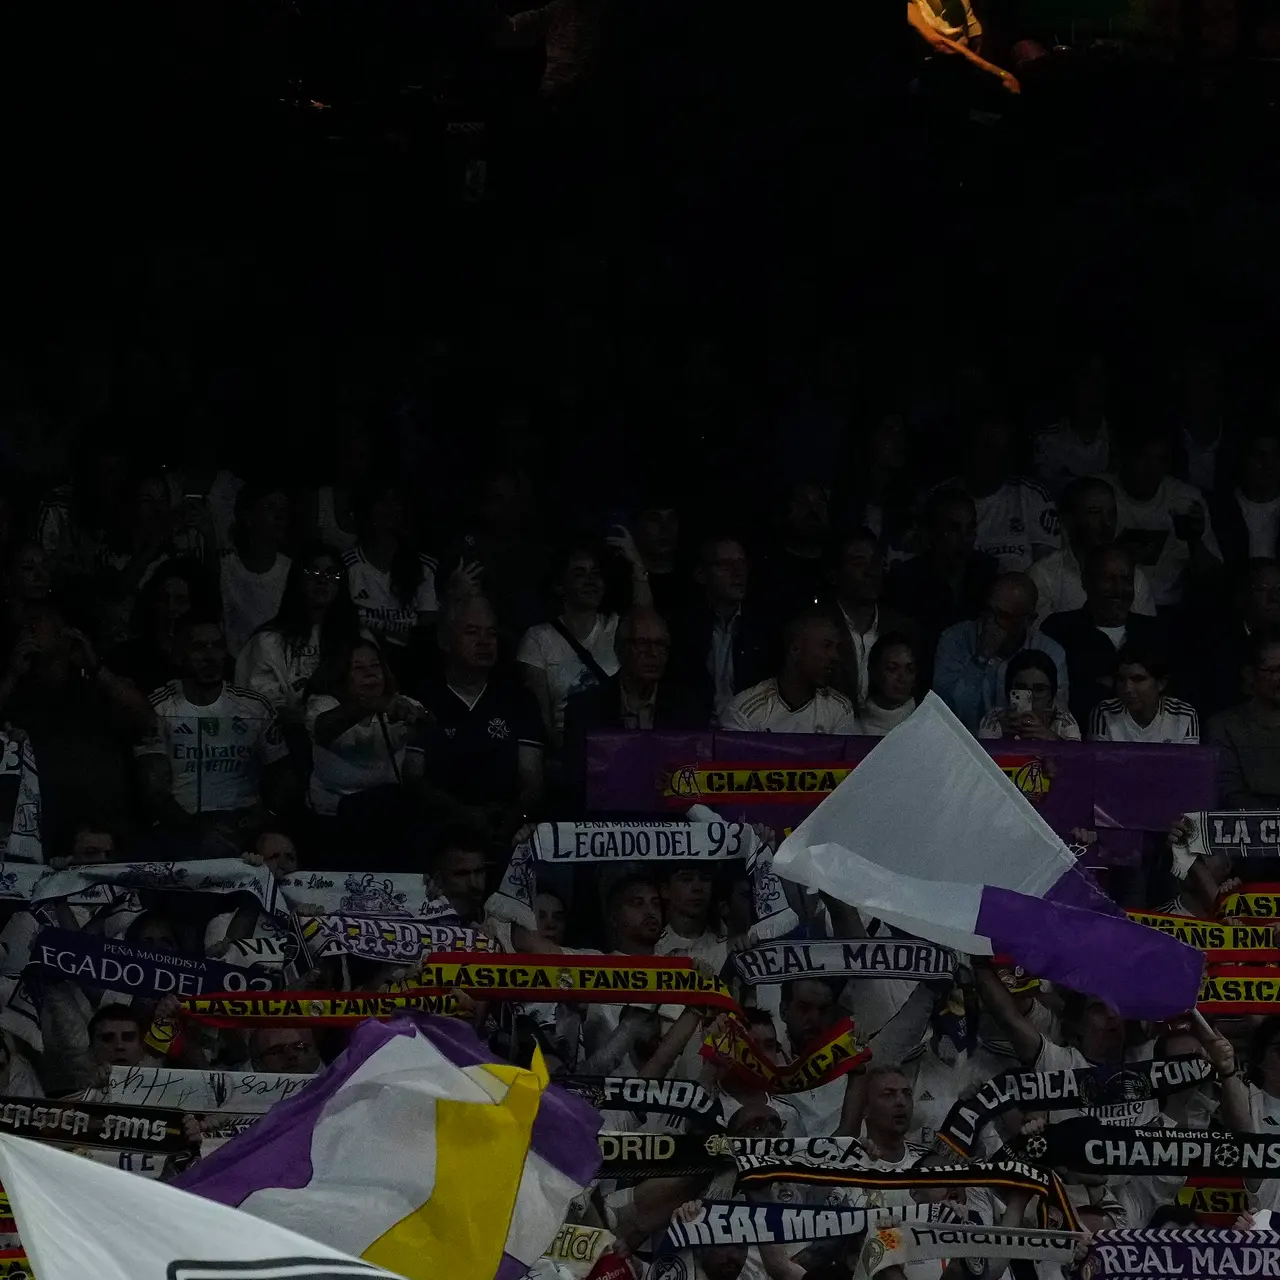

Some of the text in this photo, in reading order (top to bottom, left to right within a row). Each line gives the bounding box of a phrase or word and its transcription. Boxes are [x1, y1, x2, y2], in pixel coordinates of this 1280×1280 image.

[173, 743, 253, 759] Emirates
[552, 821, 743, 858] LEGADO DEL 93
[1213, 818, 1252, 845] LA
[103, 942, 208, 972] PEÑA MADRIDISTA
[741, 944, 825, 977] REAL
[579, 970, 649, 991] FANS
[1134, 1128, 1234, 1141] Real Madrid C.F.
[694, 1203, 775, 1245] REAL
[1099, 1245, 1185, 1278] REAL
